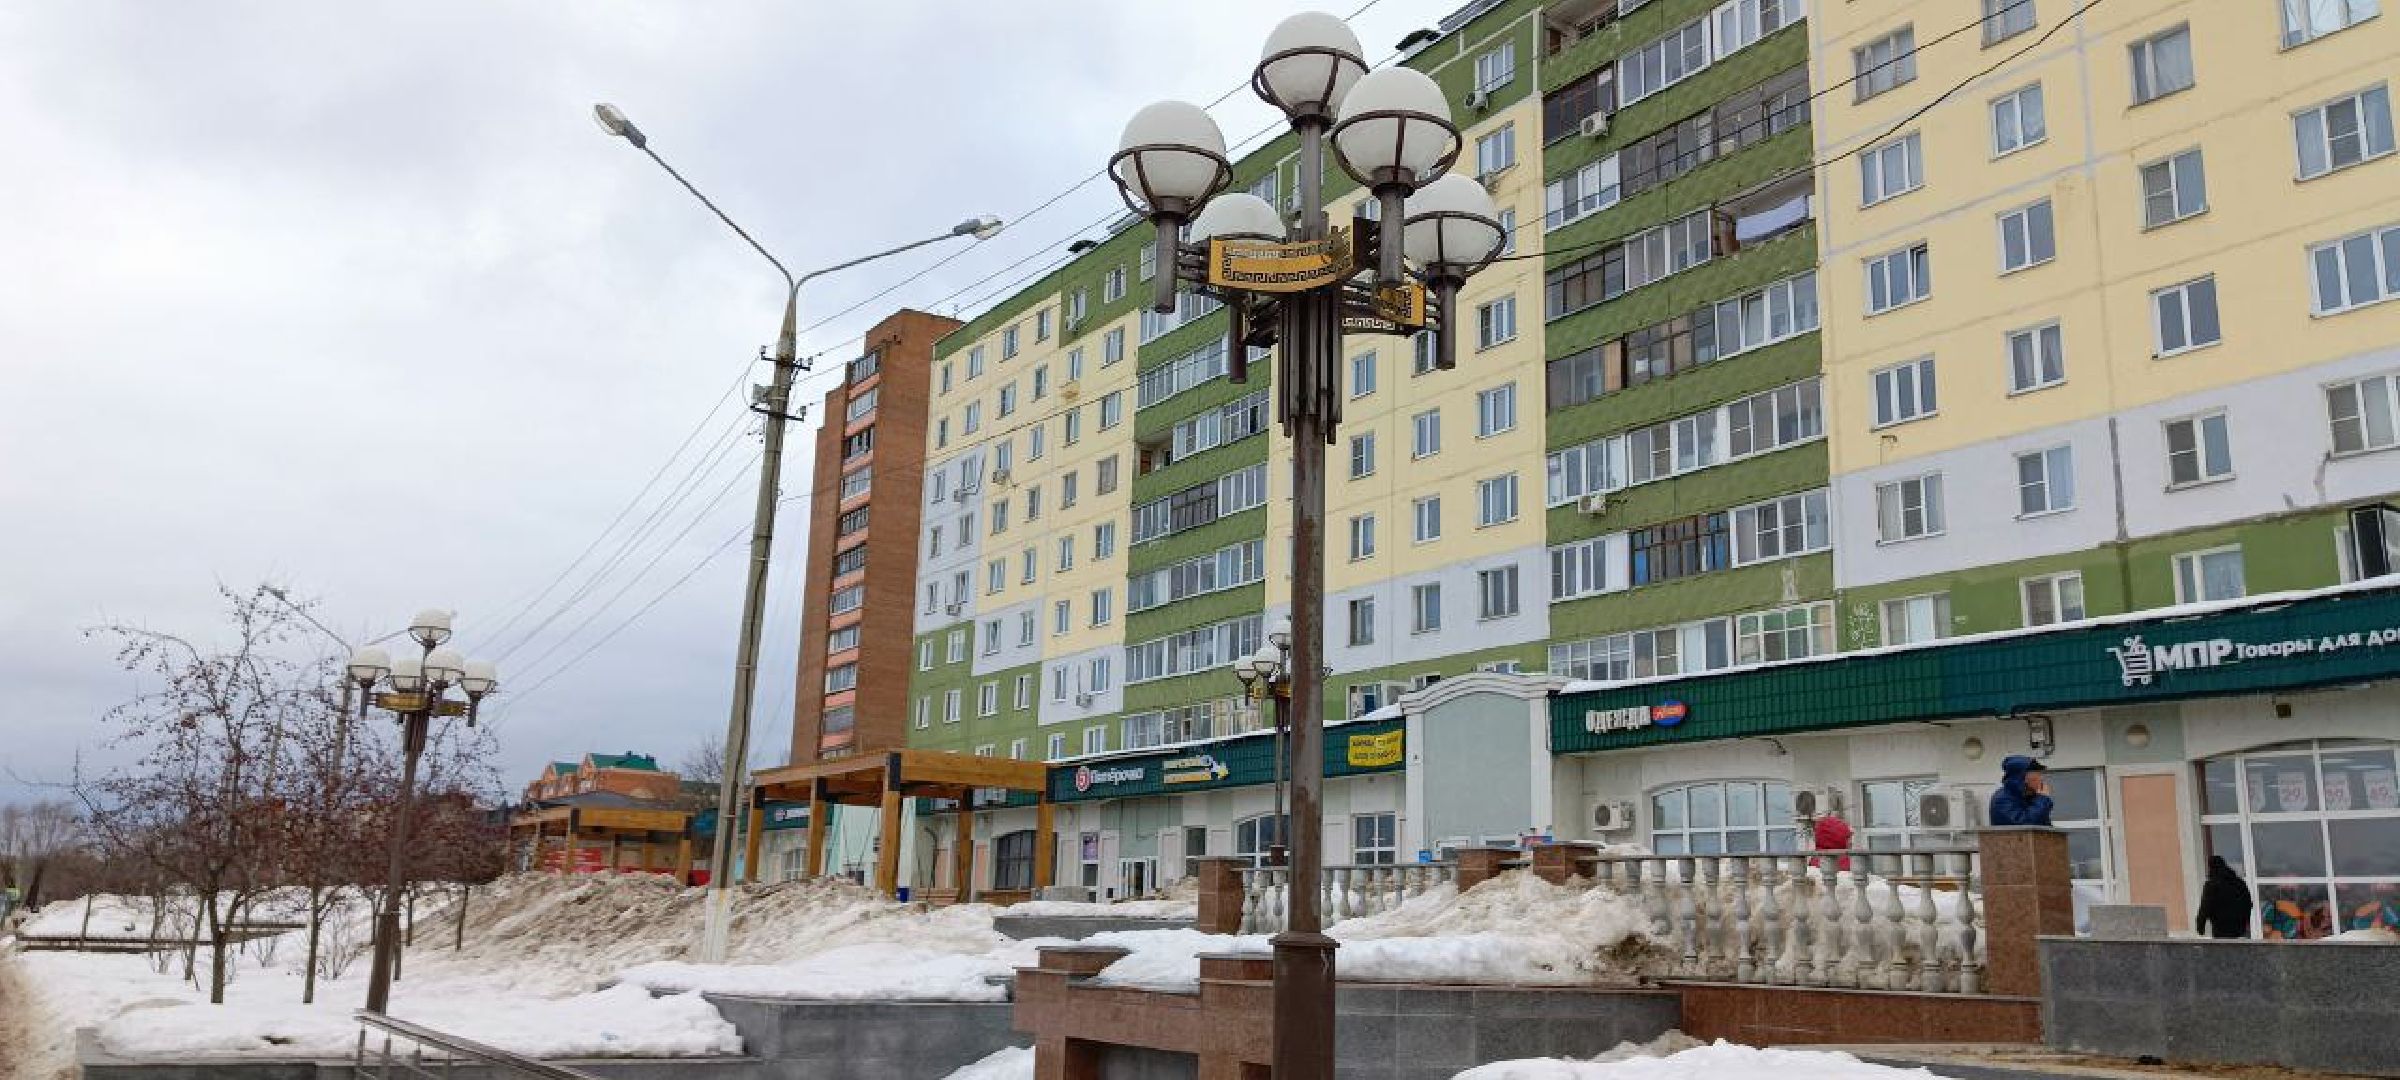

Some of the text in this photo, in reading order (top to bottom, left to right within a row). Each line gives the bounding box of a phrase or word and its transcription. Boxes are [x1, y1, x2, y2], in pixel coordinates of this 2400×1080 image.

[2154, 638, 2231, 671] МПР
[2236, 639, 2315, 660] Товары
[2367, 627, 2400, 647] до
